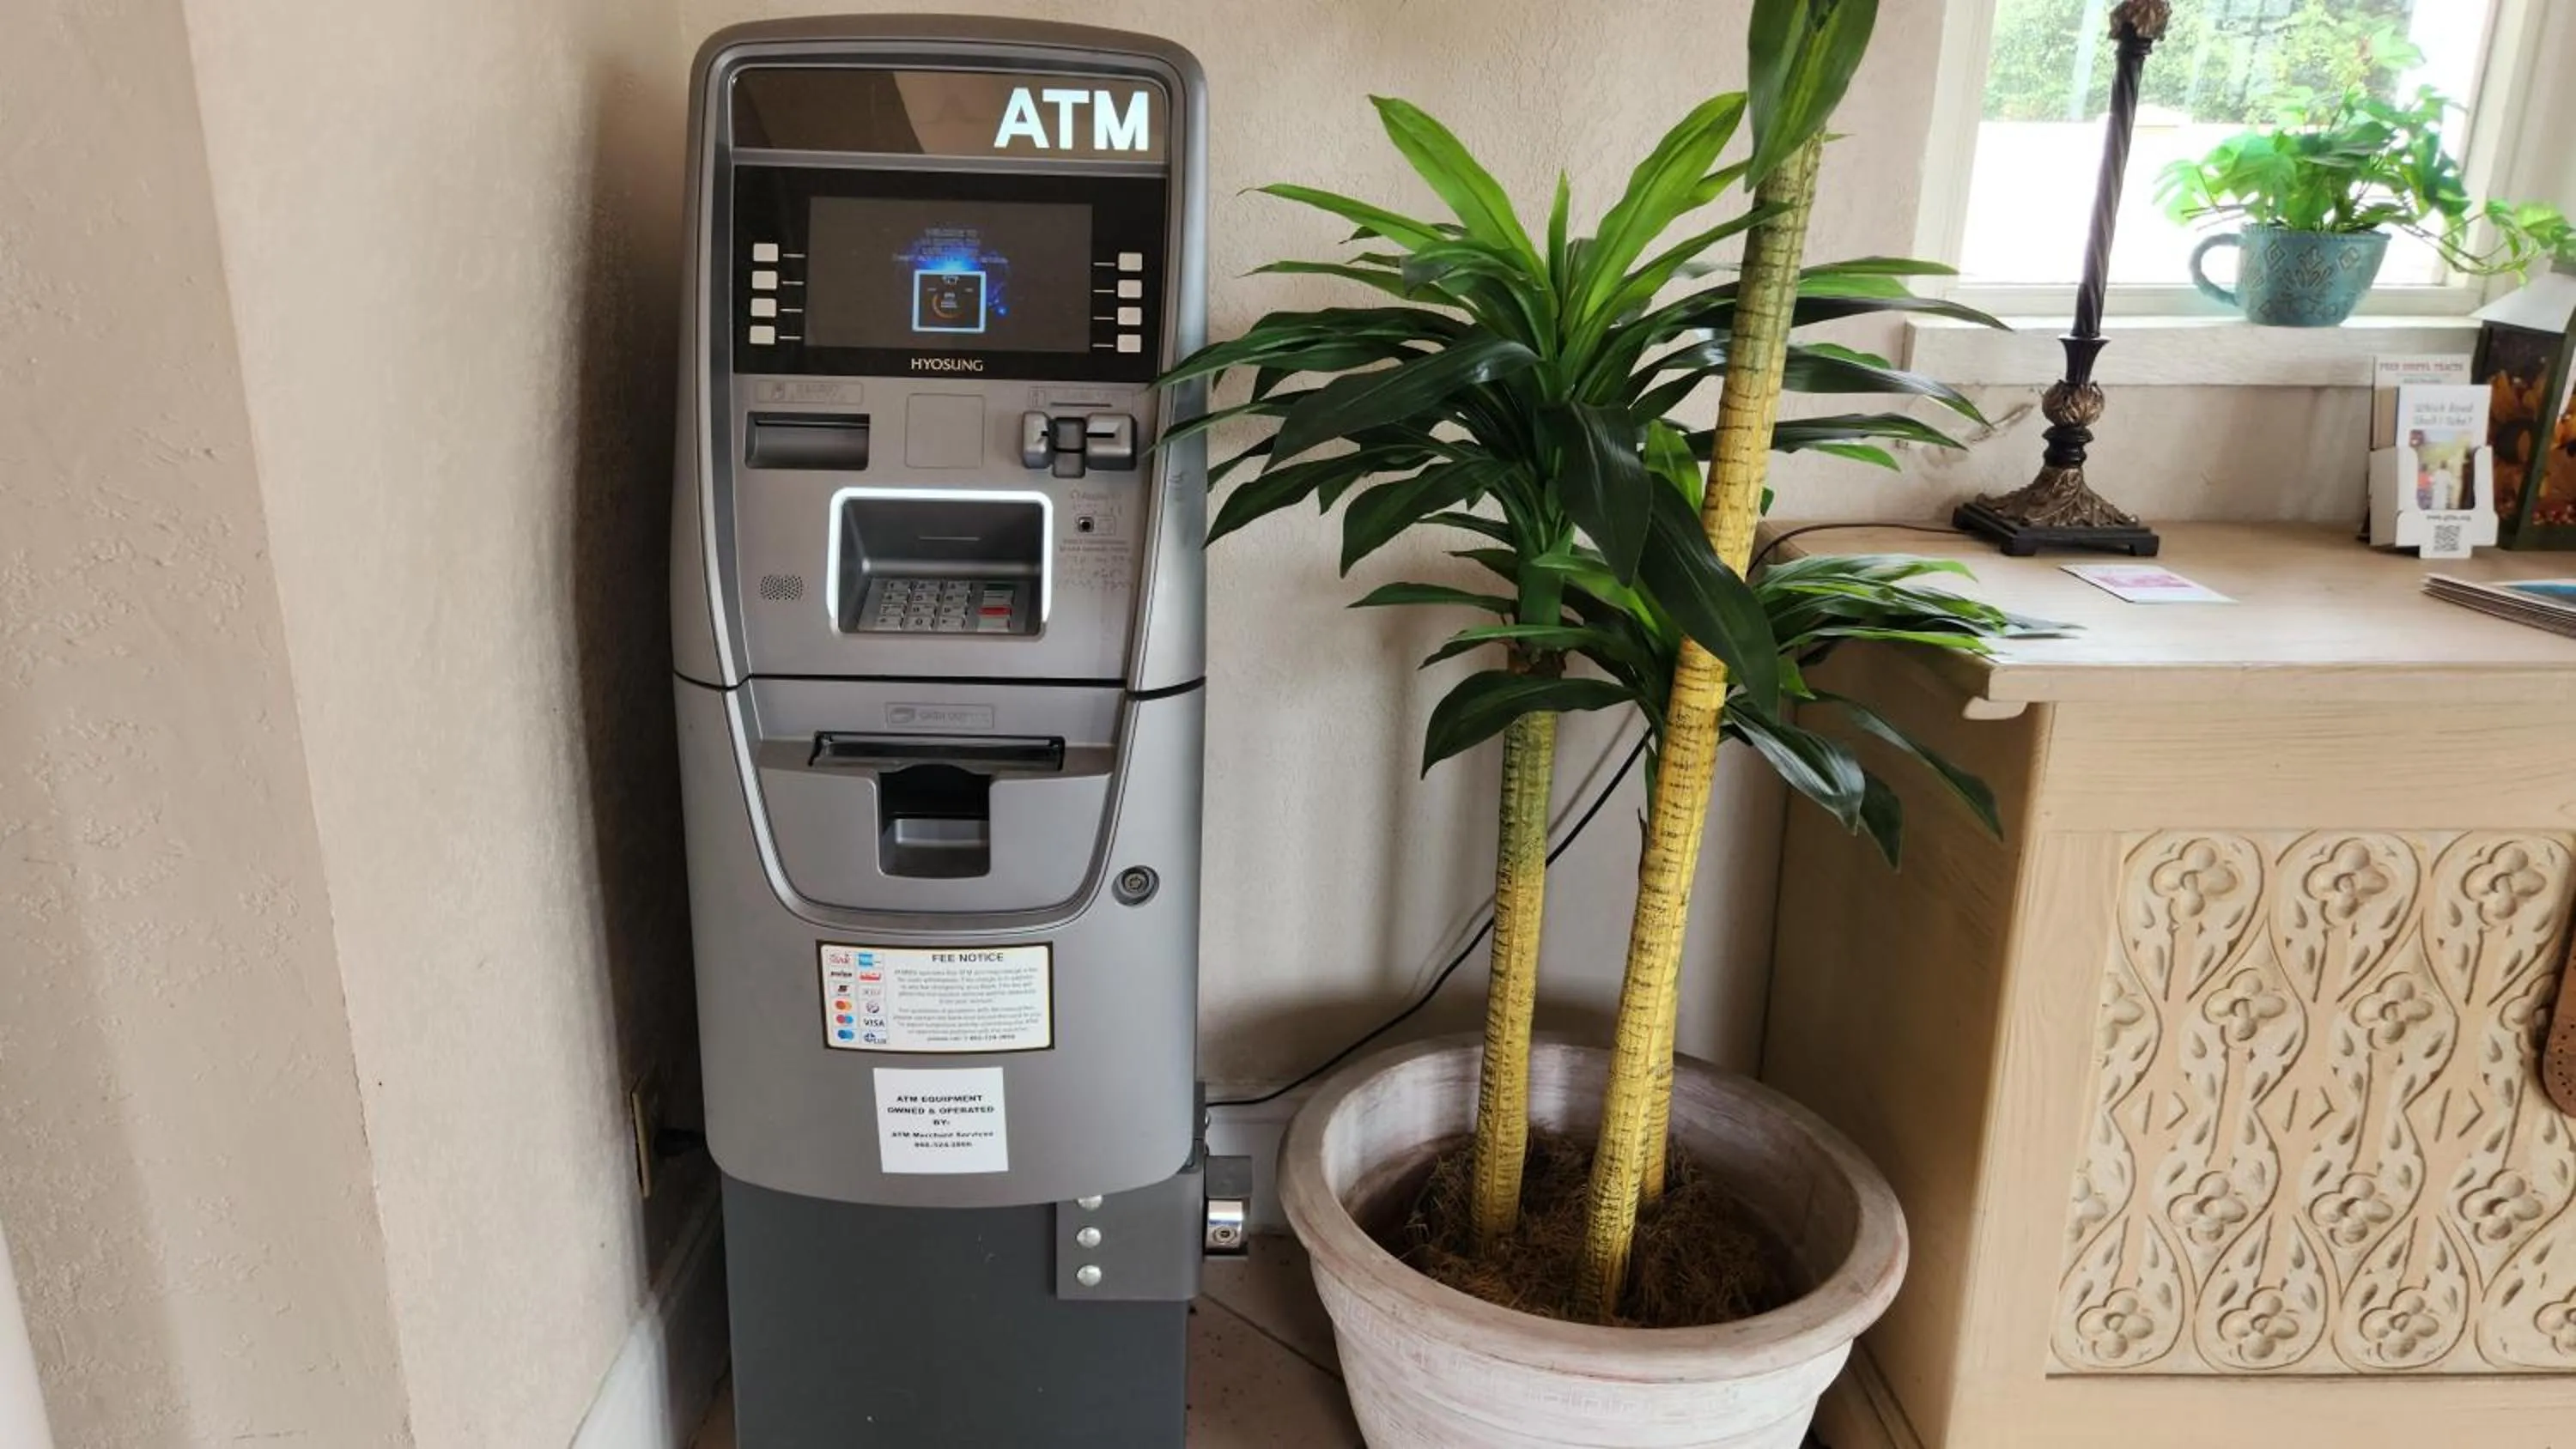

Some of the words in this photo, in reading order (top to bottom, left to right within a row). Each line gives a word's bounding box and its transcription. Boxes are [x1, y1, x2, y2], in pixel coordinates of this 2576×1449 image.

[993, 87, 1149, 151] ATM
[910, 357, 984, 372] HYOSUNG
[932, 954, 956, 963] FEE
[958, 953, 1005, 963] NOTICE
[863, 1017, 885, 1028] VISA
[896, 1094, 919, 1104] ATM
[921, 1094, 983, 1103] EQUIPMENT
[886, 1106, 926, 1115] OWNED
[939, 1106, 995, 1115] OPERATED
